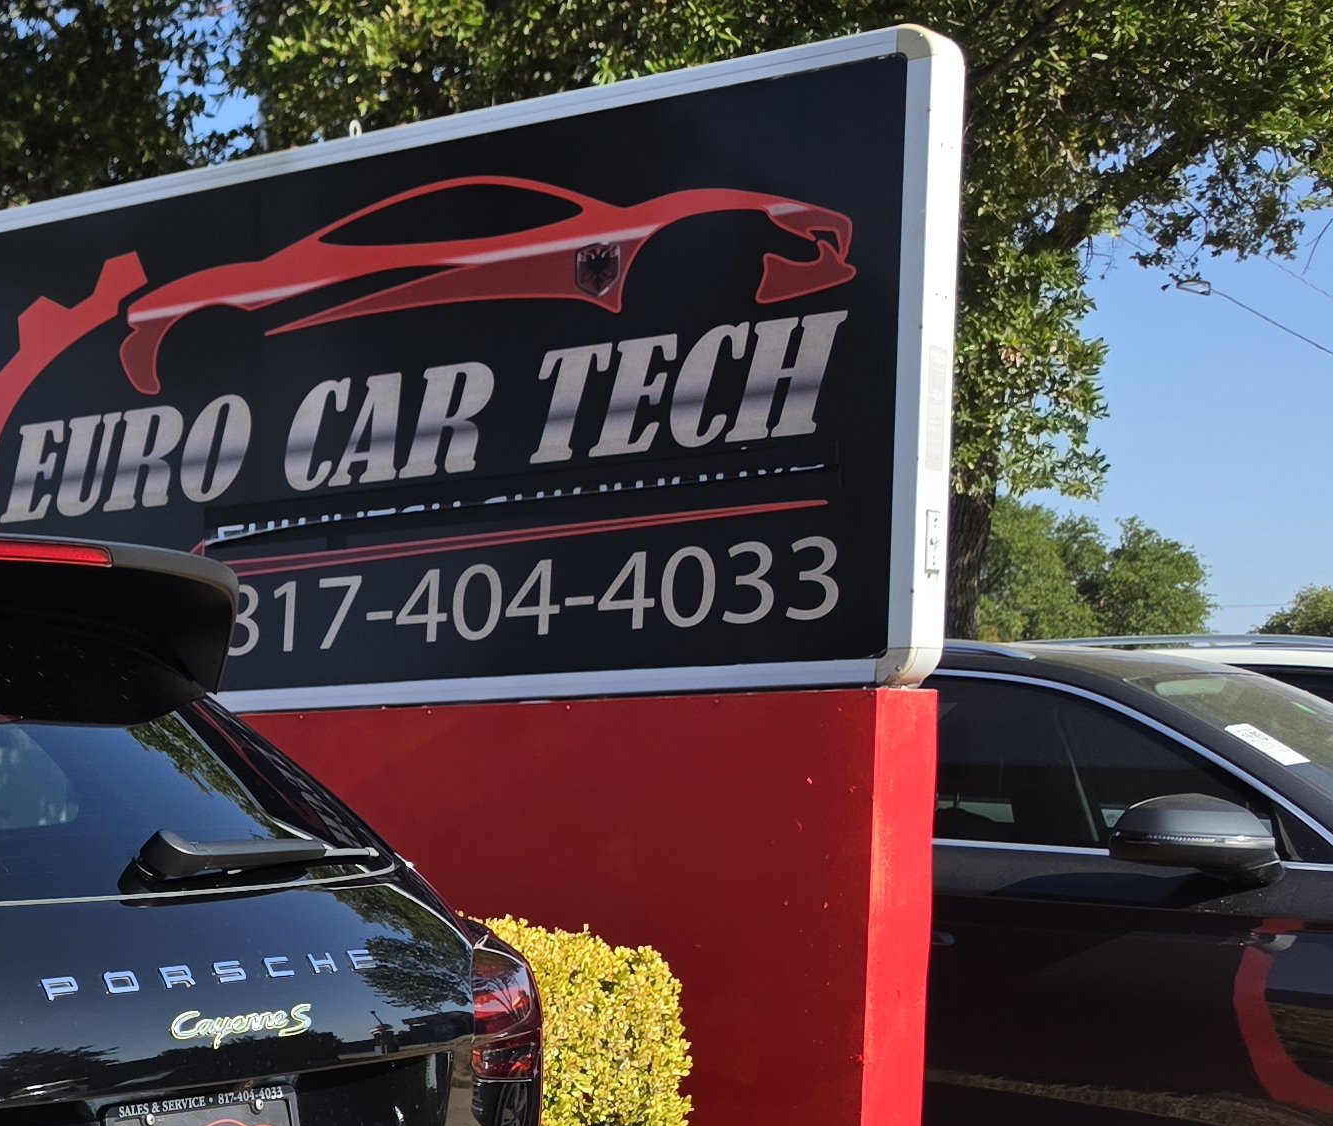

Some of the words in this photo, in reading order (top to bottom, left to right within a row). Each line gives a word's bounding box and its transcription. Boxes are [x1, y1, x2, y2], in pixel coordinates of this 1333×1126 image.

[0, 394, 252, 525] EURO
[282, 362, 495, 492] CAR
[529, 310, 847, 465] TECH
[227, 535, 840, 658] 817-404-4033
[39, 949, 377, 1001] PORSCHE
[169, 1009, 289, 1049] Cayenne
[118, 1103, 150, 1118] SALES
[151, 1103, 161, 1113] &
[162, 1096, 206, 1112] SERVICE
[217, 1086, 284, 1105] 817-404-4033
